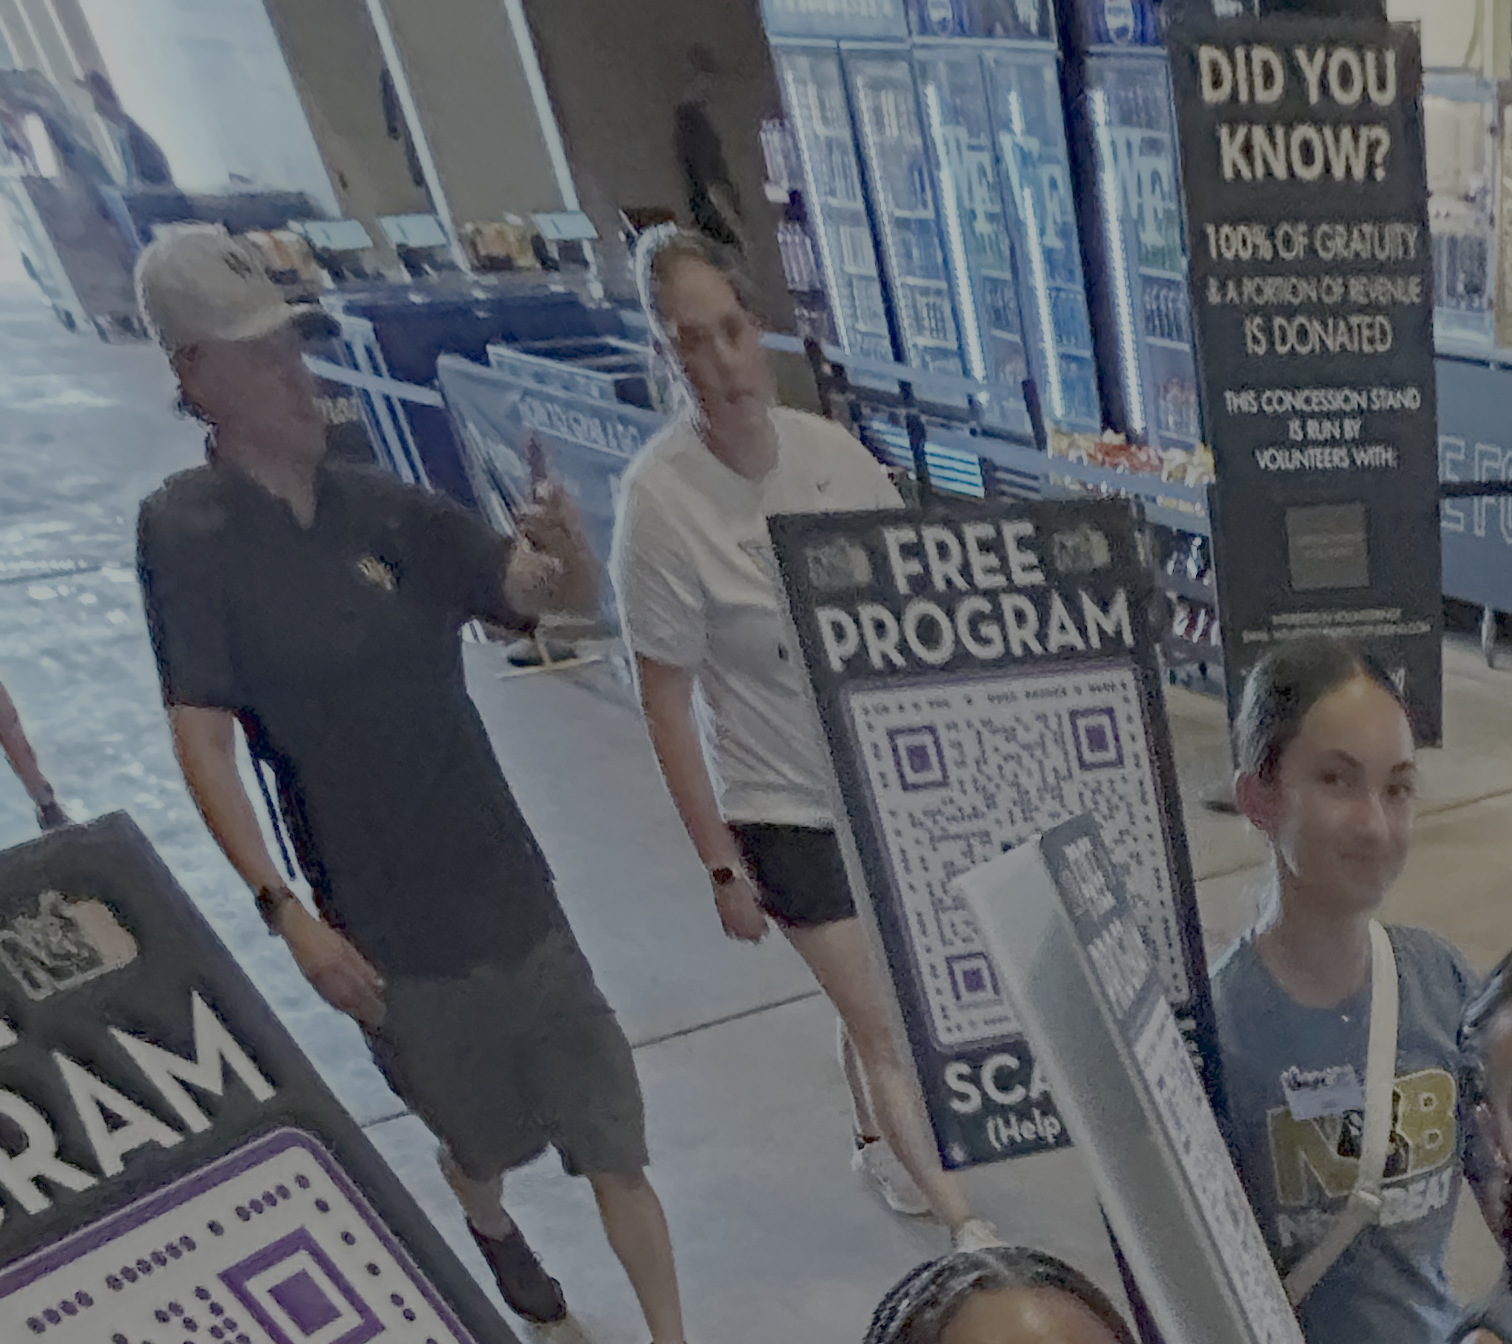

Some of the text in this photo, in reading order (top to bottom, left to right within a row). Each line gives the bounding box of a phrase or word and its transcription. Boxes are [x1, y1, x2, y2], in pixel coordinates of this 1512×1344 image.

[1199, 44, 1397, 106] DID YOU
[1219, 122, 1390, 183] KNOW?
[1206, 220, 1418, 262] 100% OF GRATUITY
[1242, 276, 1317, 304] PORTION
[1321, 276, 1344, 303] OF
[1246, 314, 1393, 355] IS DONATED
[1224, 384, 1421, 416] THIS CONCESSION STAND
[1289, 418, 1362, 441] IS RUN BY
[1255, 447, 1349, 471] VOLUNTEERS
[882, 519, 1046, 595] FREE
[815, 587, 1135, 673] PROGRAM
[0, 985, 277, 1215] RAM
[944, 1052, 1051, 1115] SCA
[986, 1106, 1062, 1151] (Help
